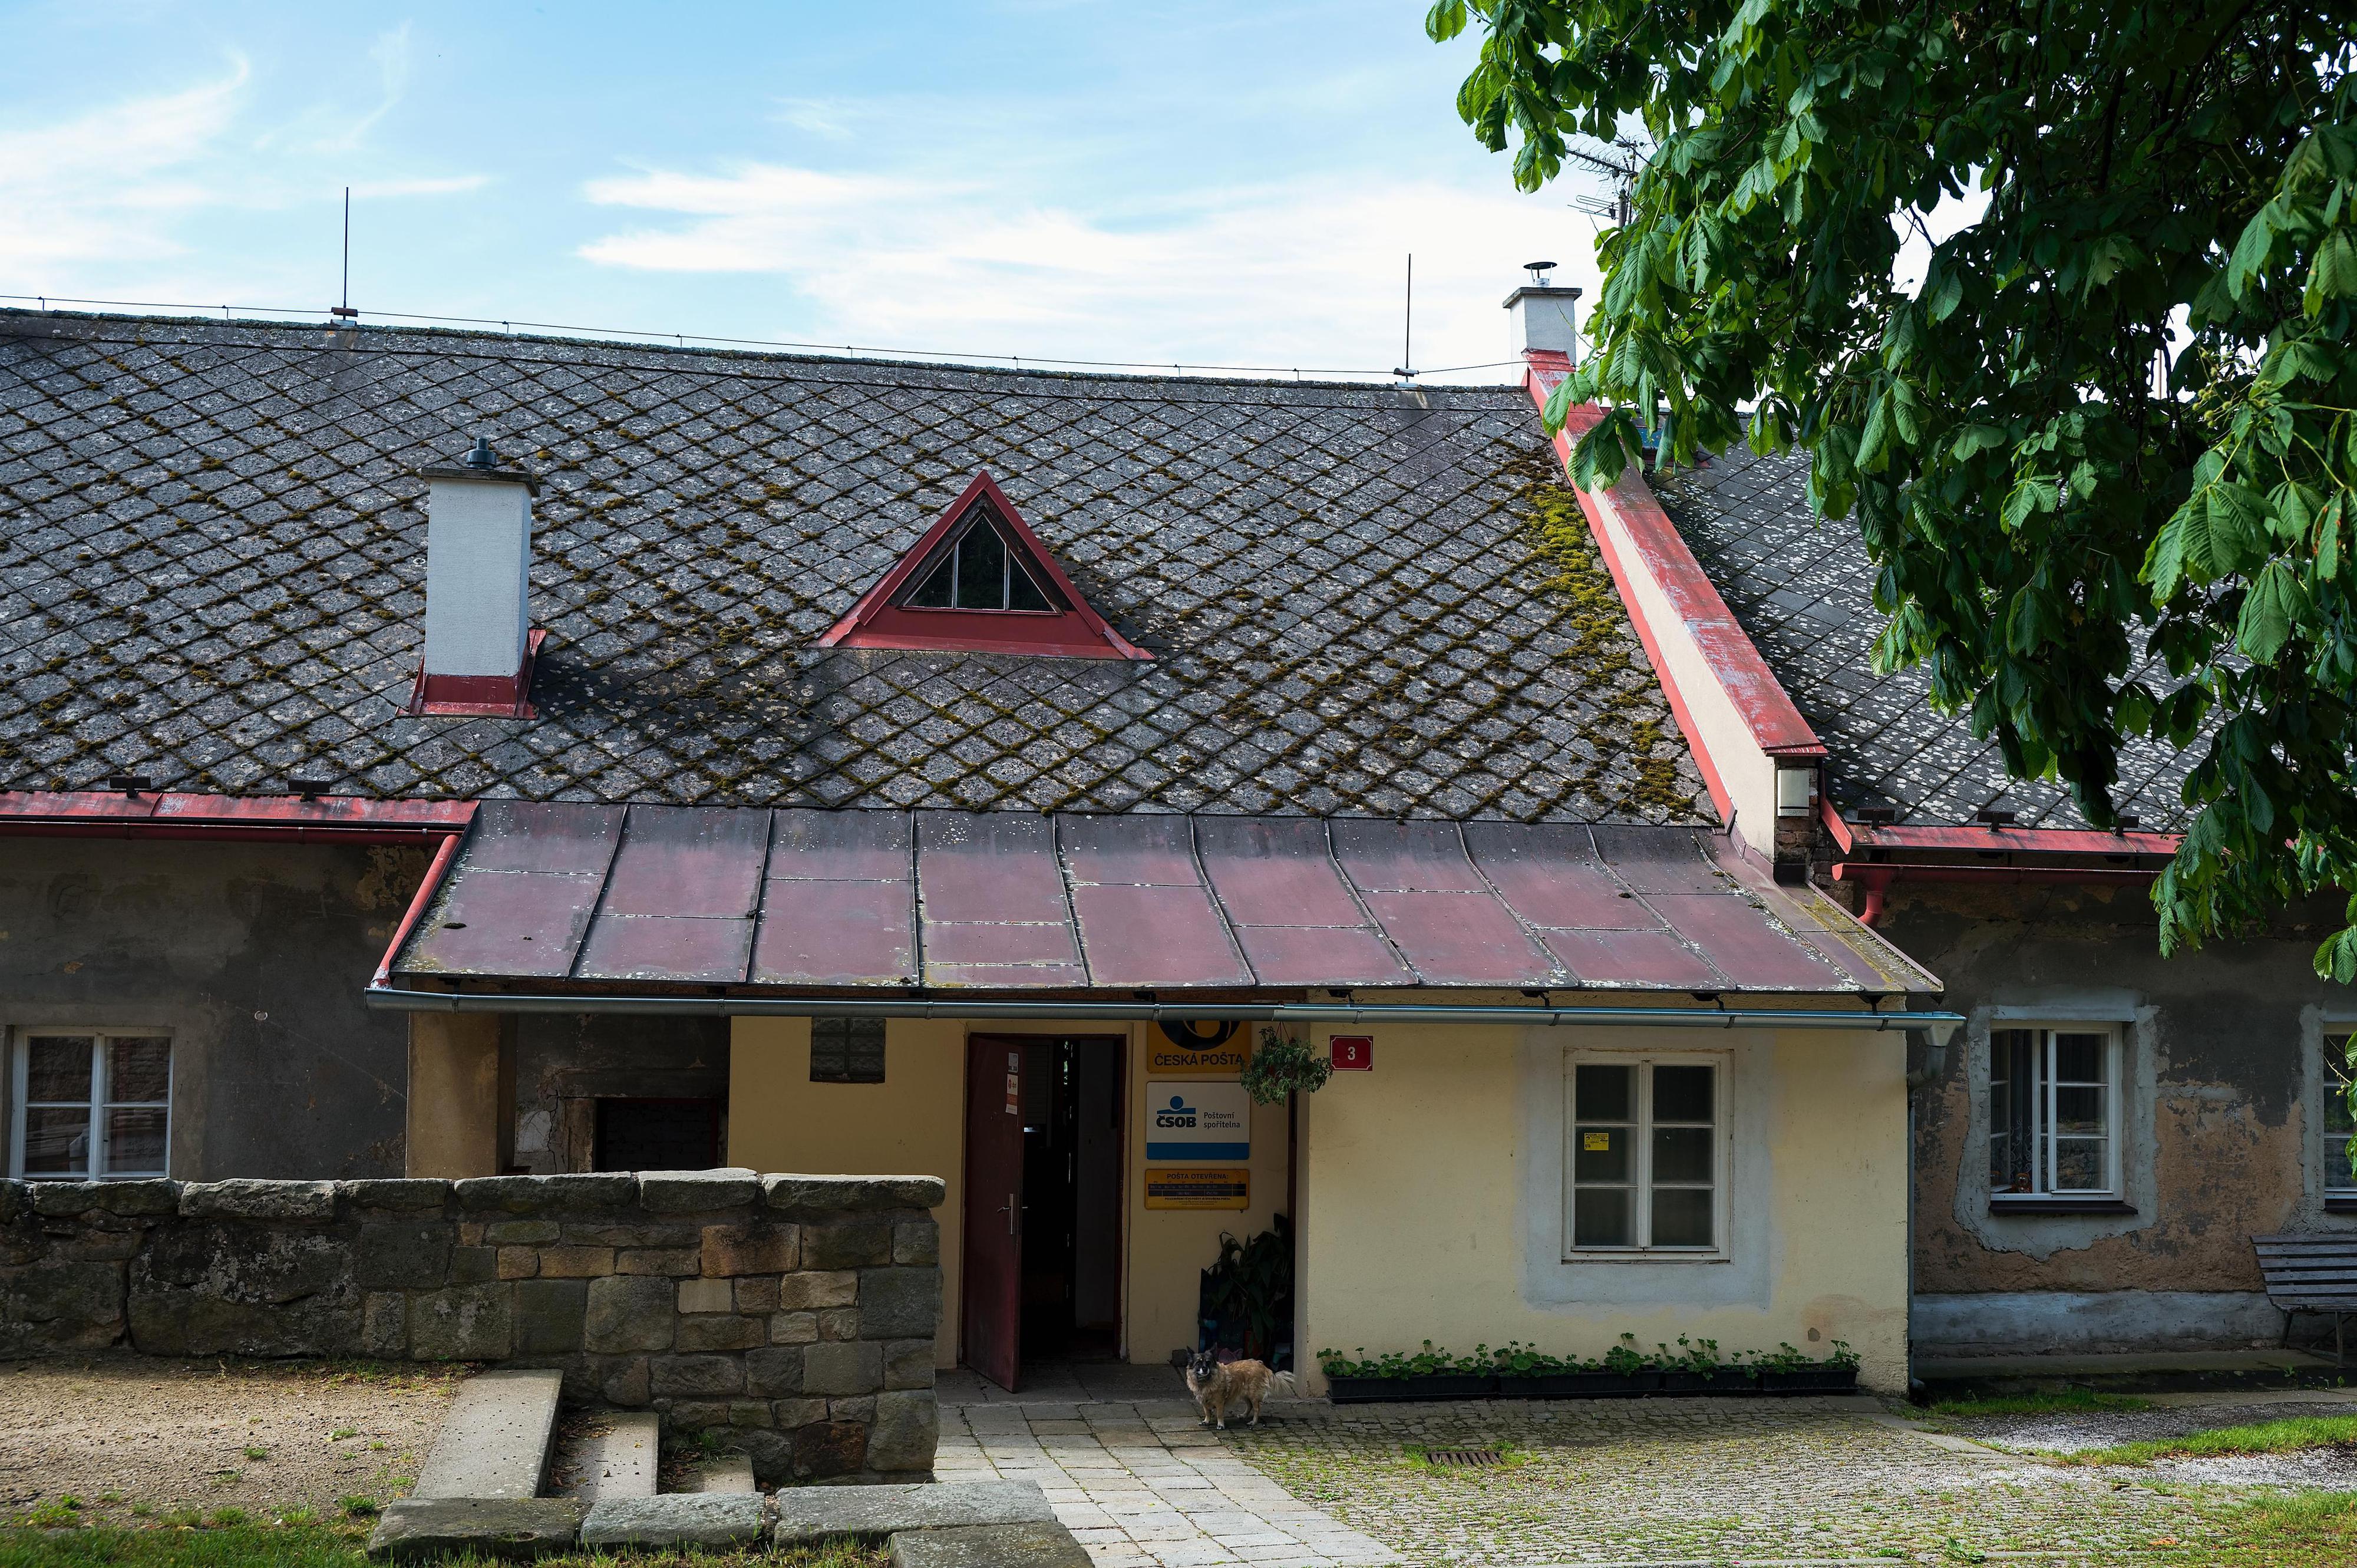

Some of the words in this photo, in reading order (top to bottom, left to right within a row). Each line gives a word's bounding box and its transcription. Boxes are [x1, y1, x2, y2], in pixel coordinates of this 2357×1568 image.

[1154, 1052, 1198, 1066] ČESKÁ
[1201, 1052, 1244, 1065] POŠTA
[1348, 1046, 1355, 1060] 3
[1156, 1115, 1197, 1128] ČSOB
[1203, 1121, 1240, 1129] spořitelna
